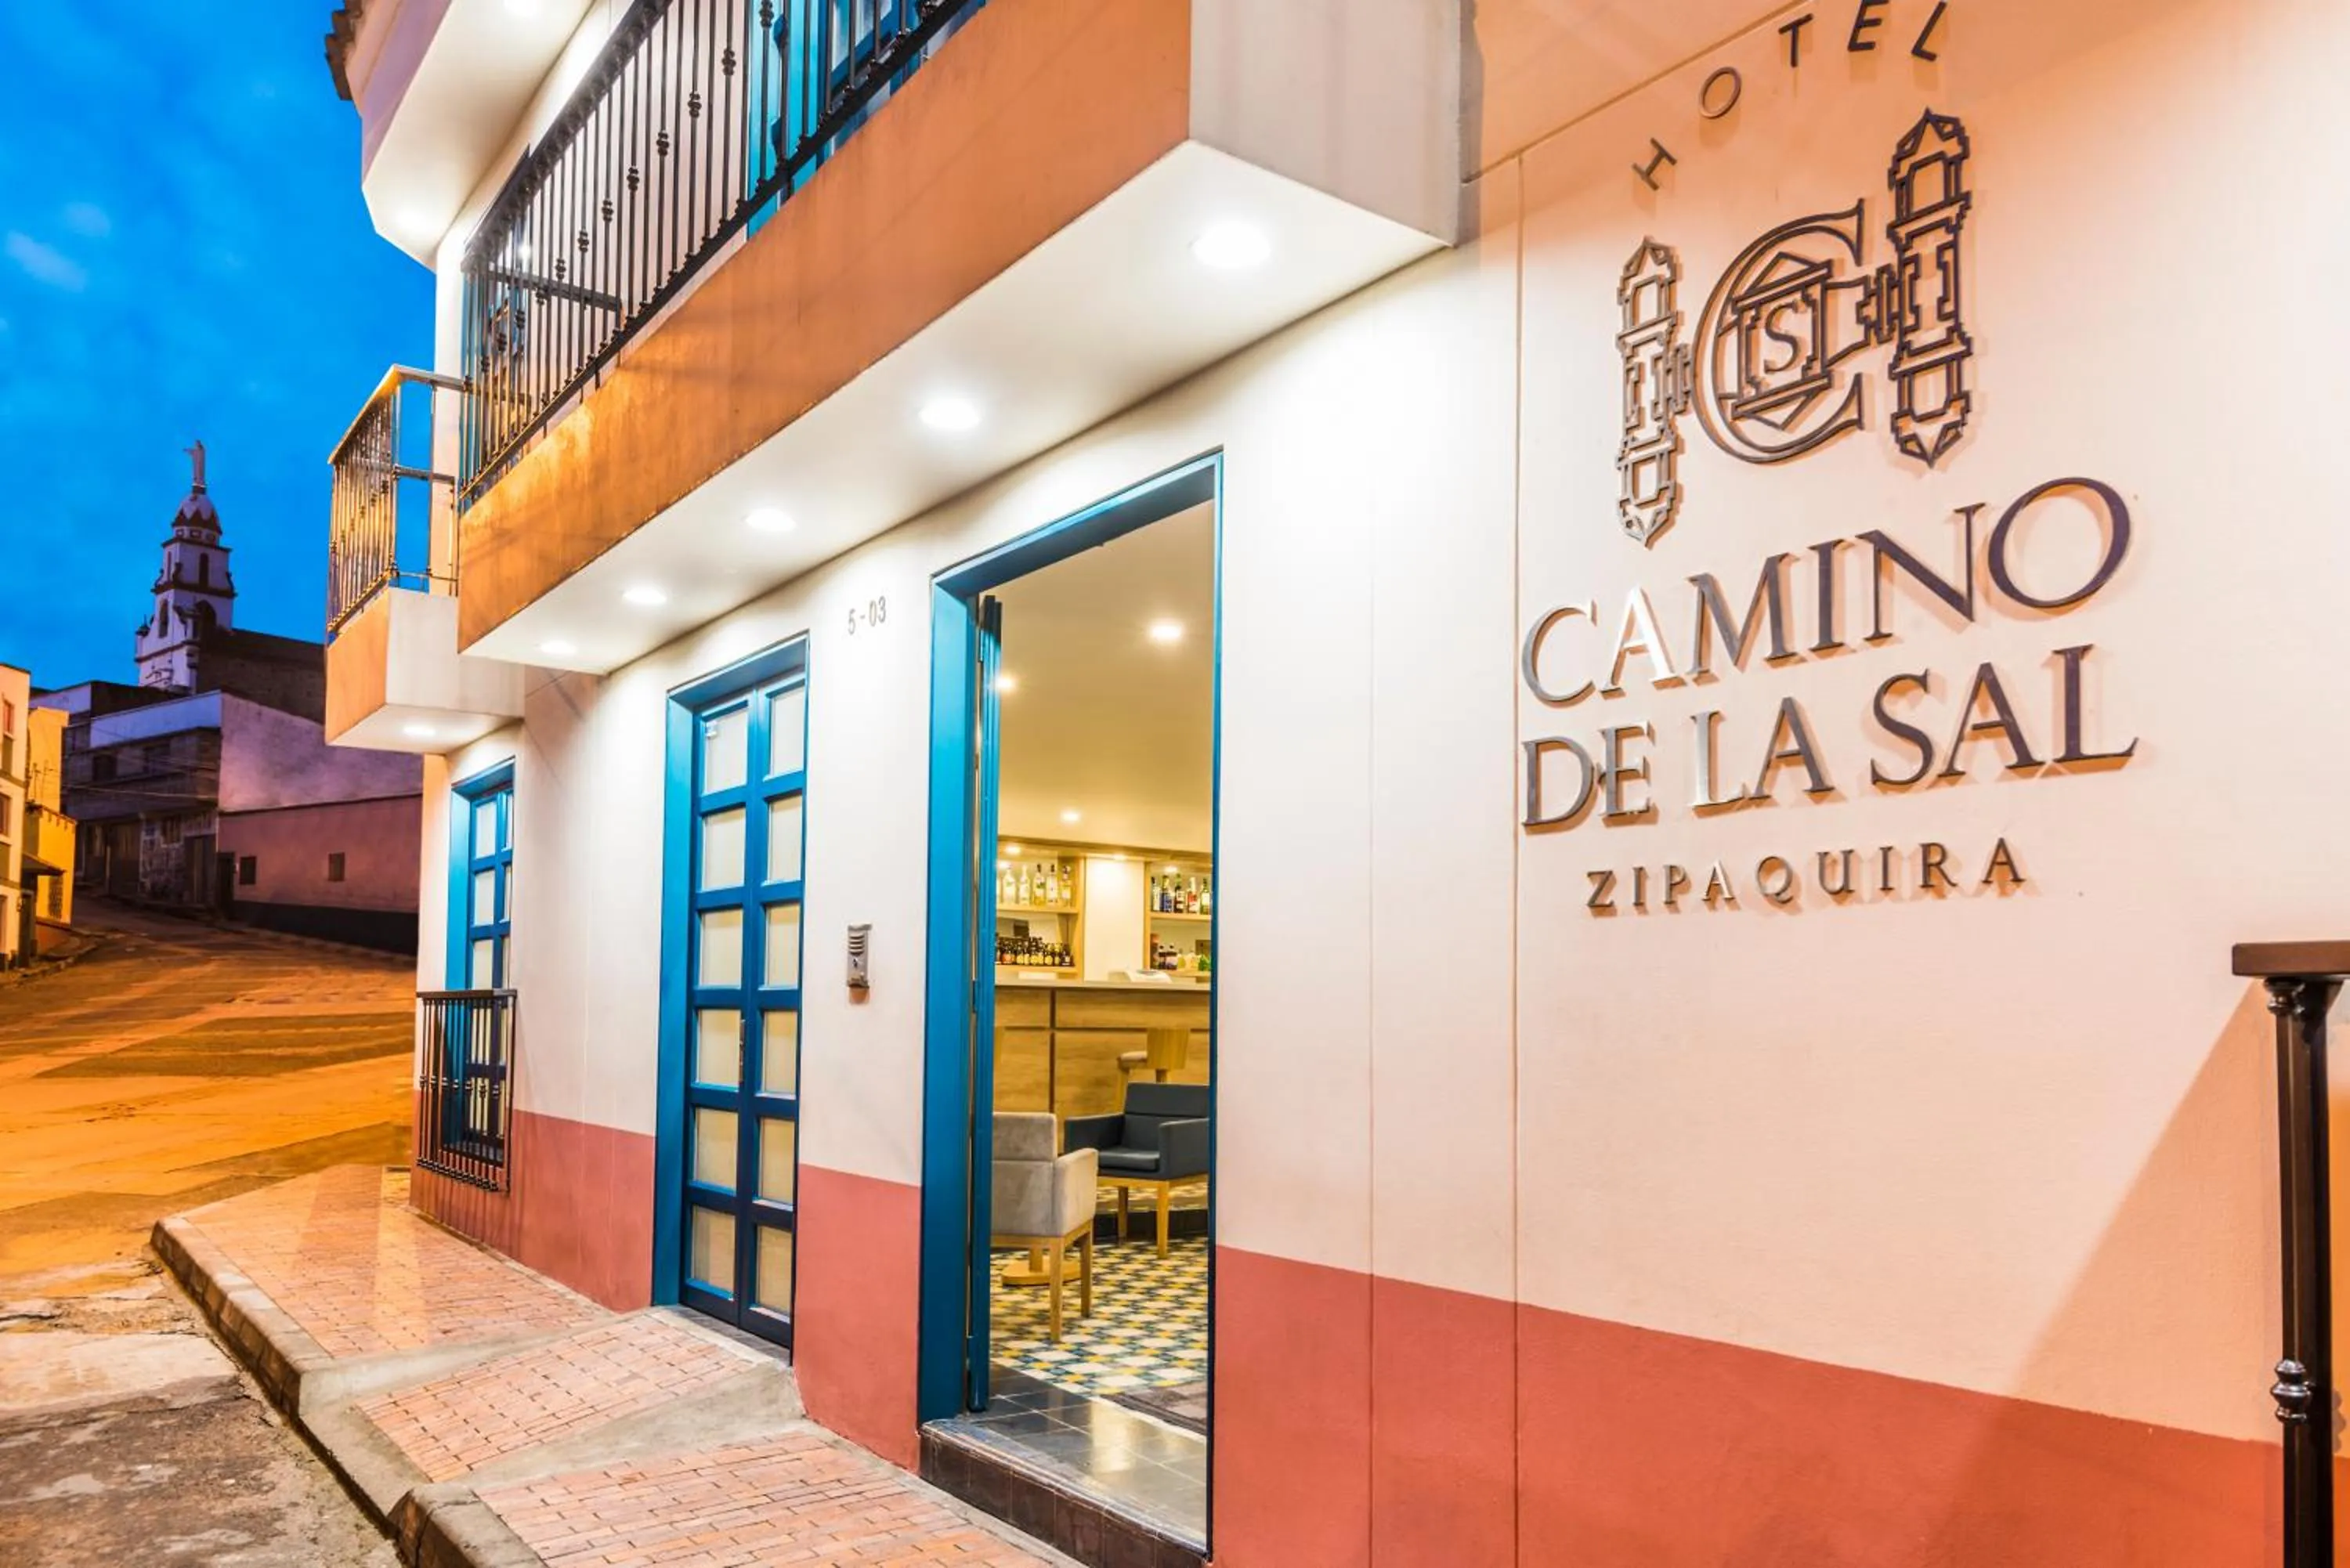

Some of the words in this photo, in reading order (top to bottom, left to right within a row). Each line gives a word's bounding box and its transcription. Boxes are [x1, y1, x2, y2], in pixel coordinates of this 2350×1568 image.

[1632, 0, 1947, 191] HOTEL
[1522, 476, 2131, 702] CAMINO
[1522, 721, 1653, 827] DE
[1689, 696, 1835, 808] LA
[1870, 644, 2139, 786] SAL
[1585, 837, 2026, 909] ZIPAQUIRA
